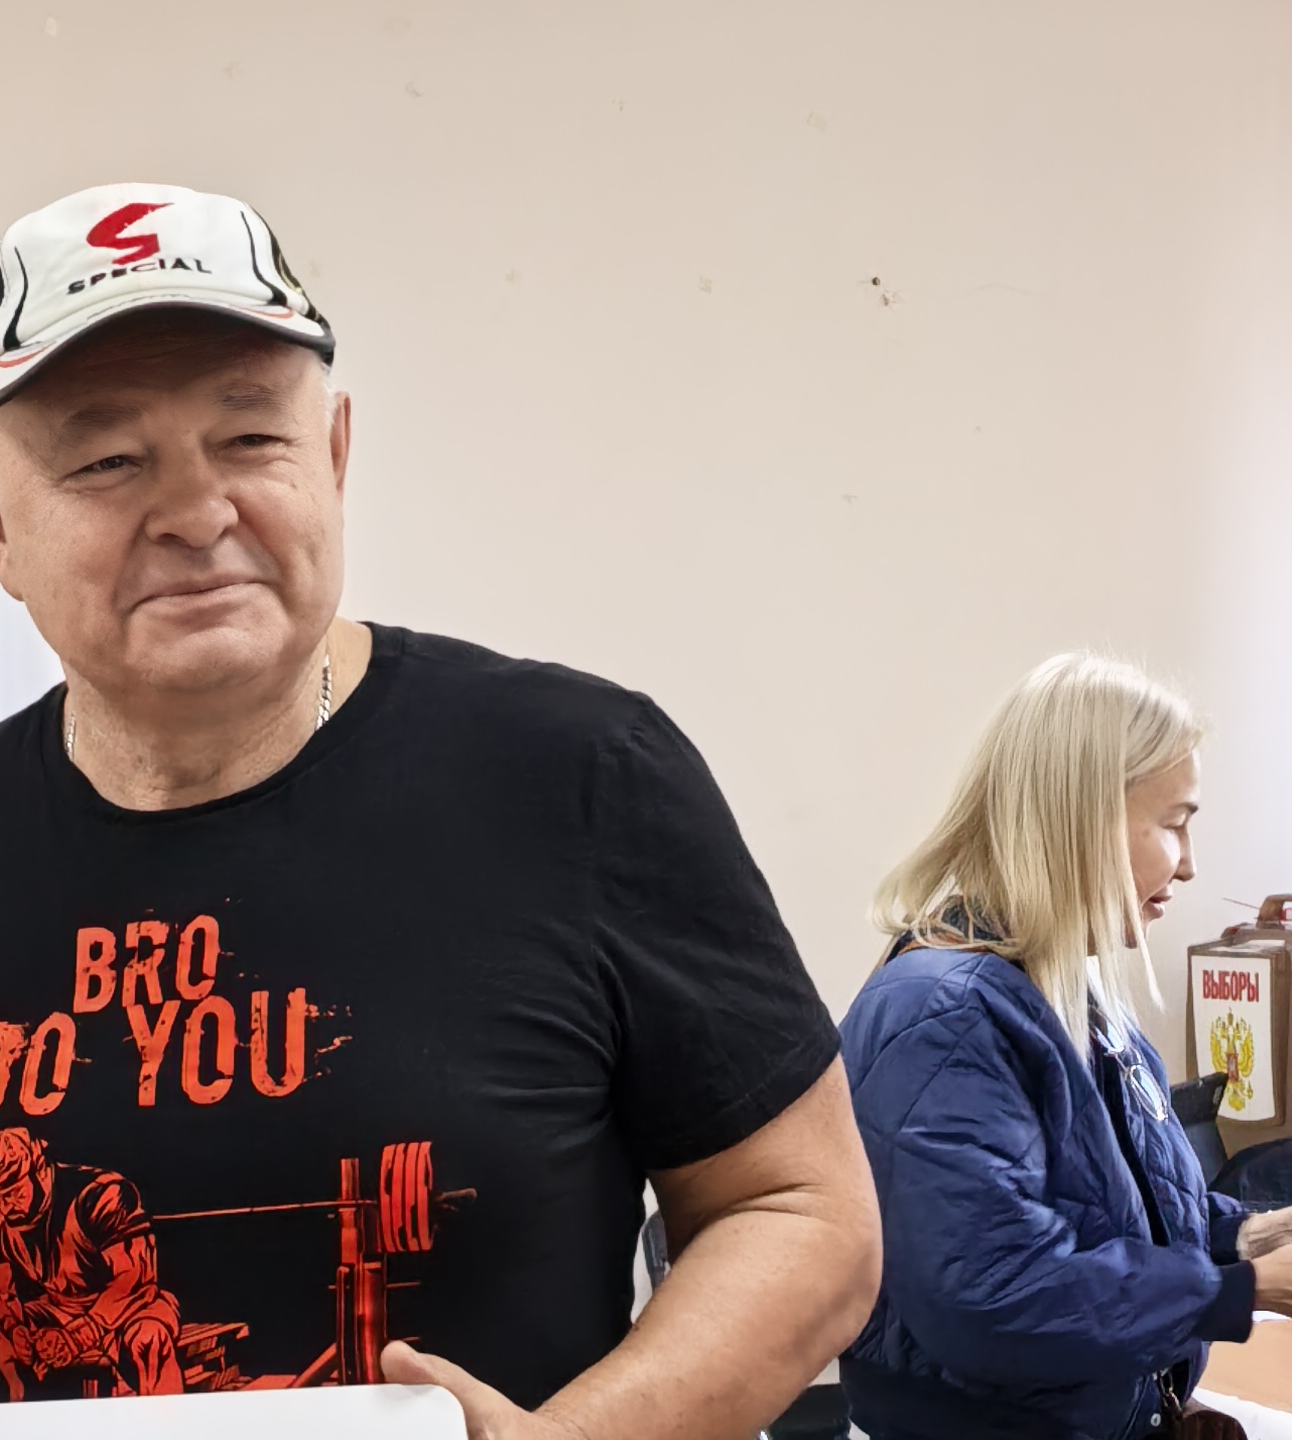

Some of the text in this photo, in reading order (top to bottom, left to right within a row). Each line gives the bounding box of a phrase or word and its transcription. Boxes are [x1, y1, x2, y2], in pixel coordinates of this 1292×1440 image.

[67, 258, 212, 295] SPECIAL
[73, 914, 220, 1013] BRO
[1202, 969, 1259, 1002] ВЫБОРЫ
[126, 987, 307, 1107] YOU
